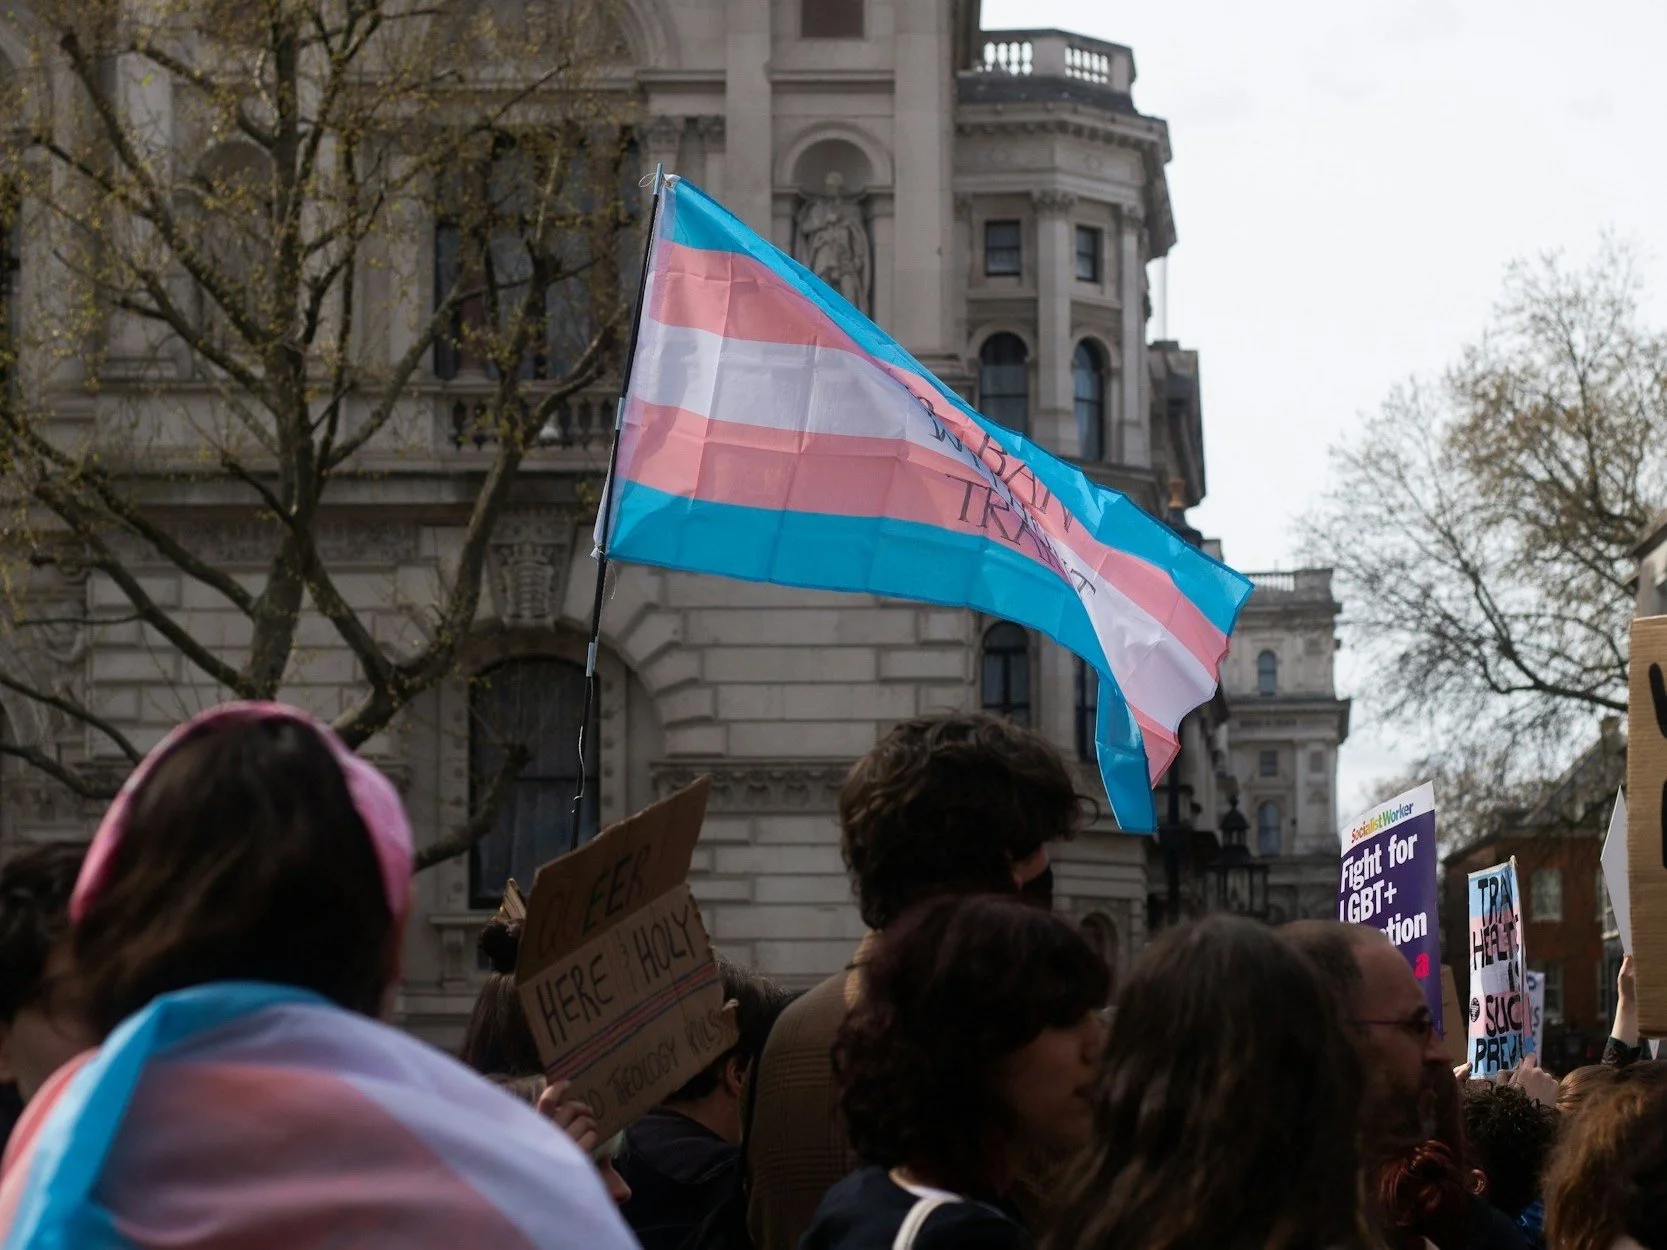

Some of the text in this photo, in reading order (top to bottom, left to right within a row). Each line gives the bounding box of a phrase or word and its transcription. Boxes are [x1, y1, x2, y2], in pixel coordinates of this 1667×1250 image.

[537, 843, 650, 959] QUEER
[1340, 834, 1418, 893] Fight for
[536, 954, 613, 1047] HERE
[633, 904, 696, 985] HOLY
